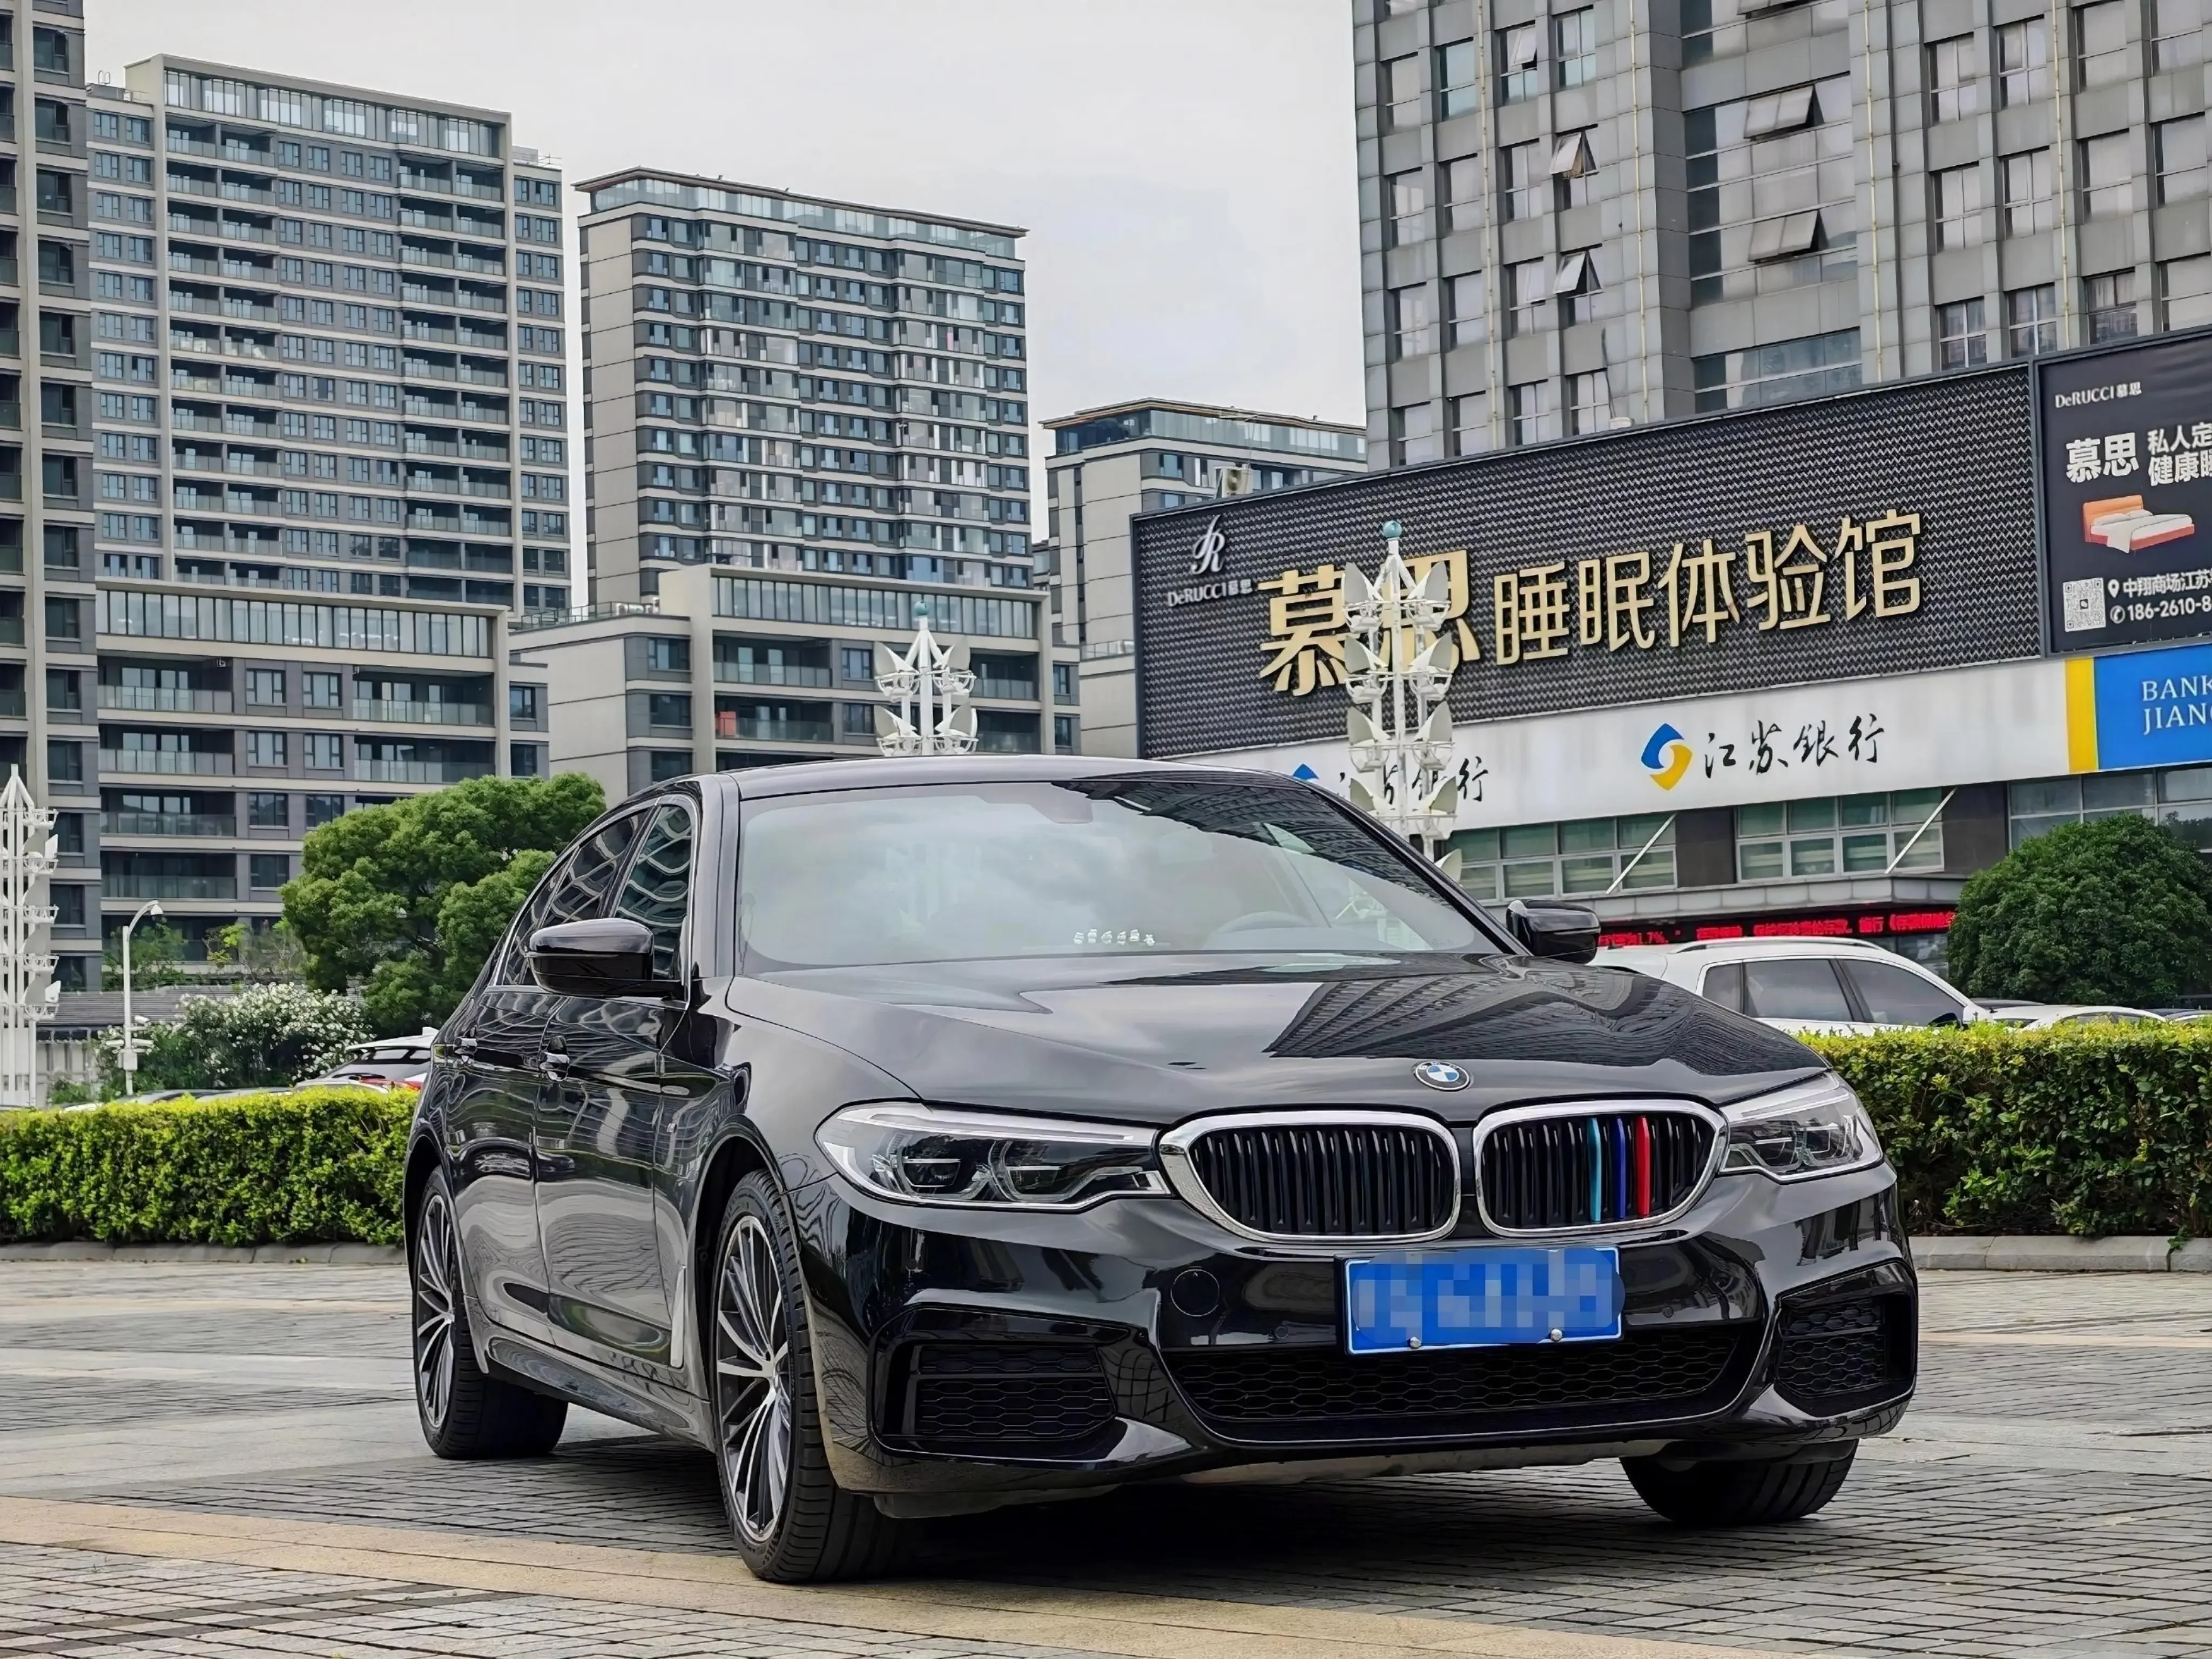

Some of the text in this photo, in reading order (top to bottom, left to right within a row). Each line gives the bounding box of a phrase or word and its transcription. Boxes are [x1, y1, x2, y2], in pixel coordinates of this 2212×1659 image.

[2055, 381, 2142, 408] DeRUCCI 慕思
[2147, 422, 2212, 455] 私人定
[2065, 432, 2140, 483] 慕思
[1168, 582, 1227, 608] DeRUCCI
[2122, 568, 2212, 598] 中翔商场江苏
[2141, 674, 2212, 702] BANK
[2142, 702, 2212, 736] JIAN
[1704, 713, 1885, 779] 江苏银行
